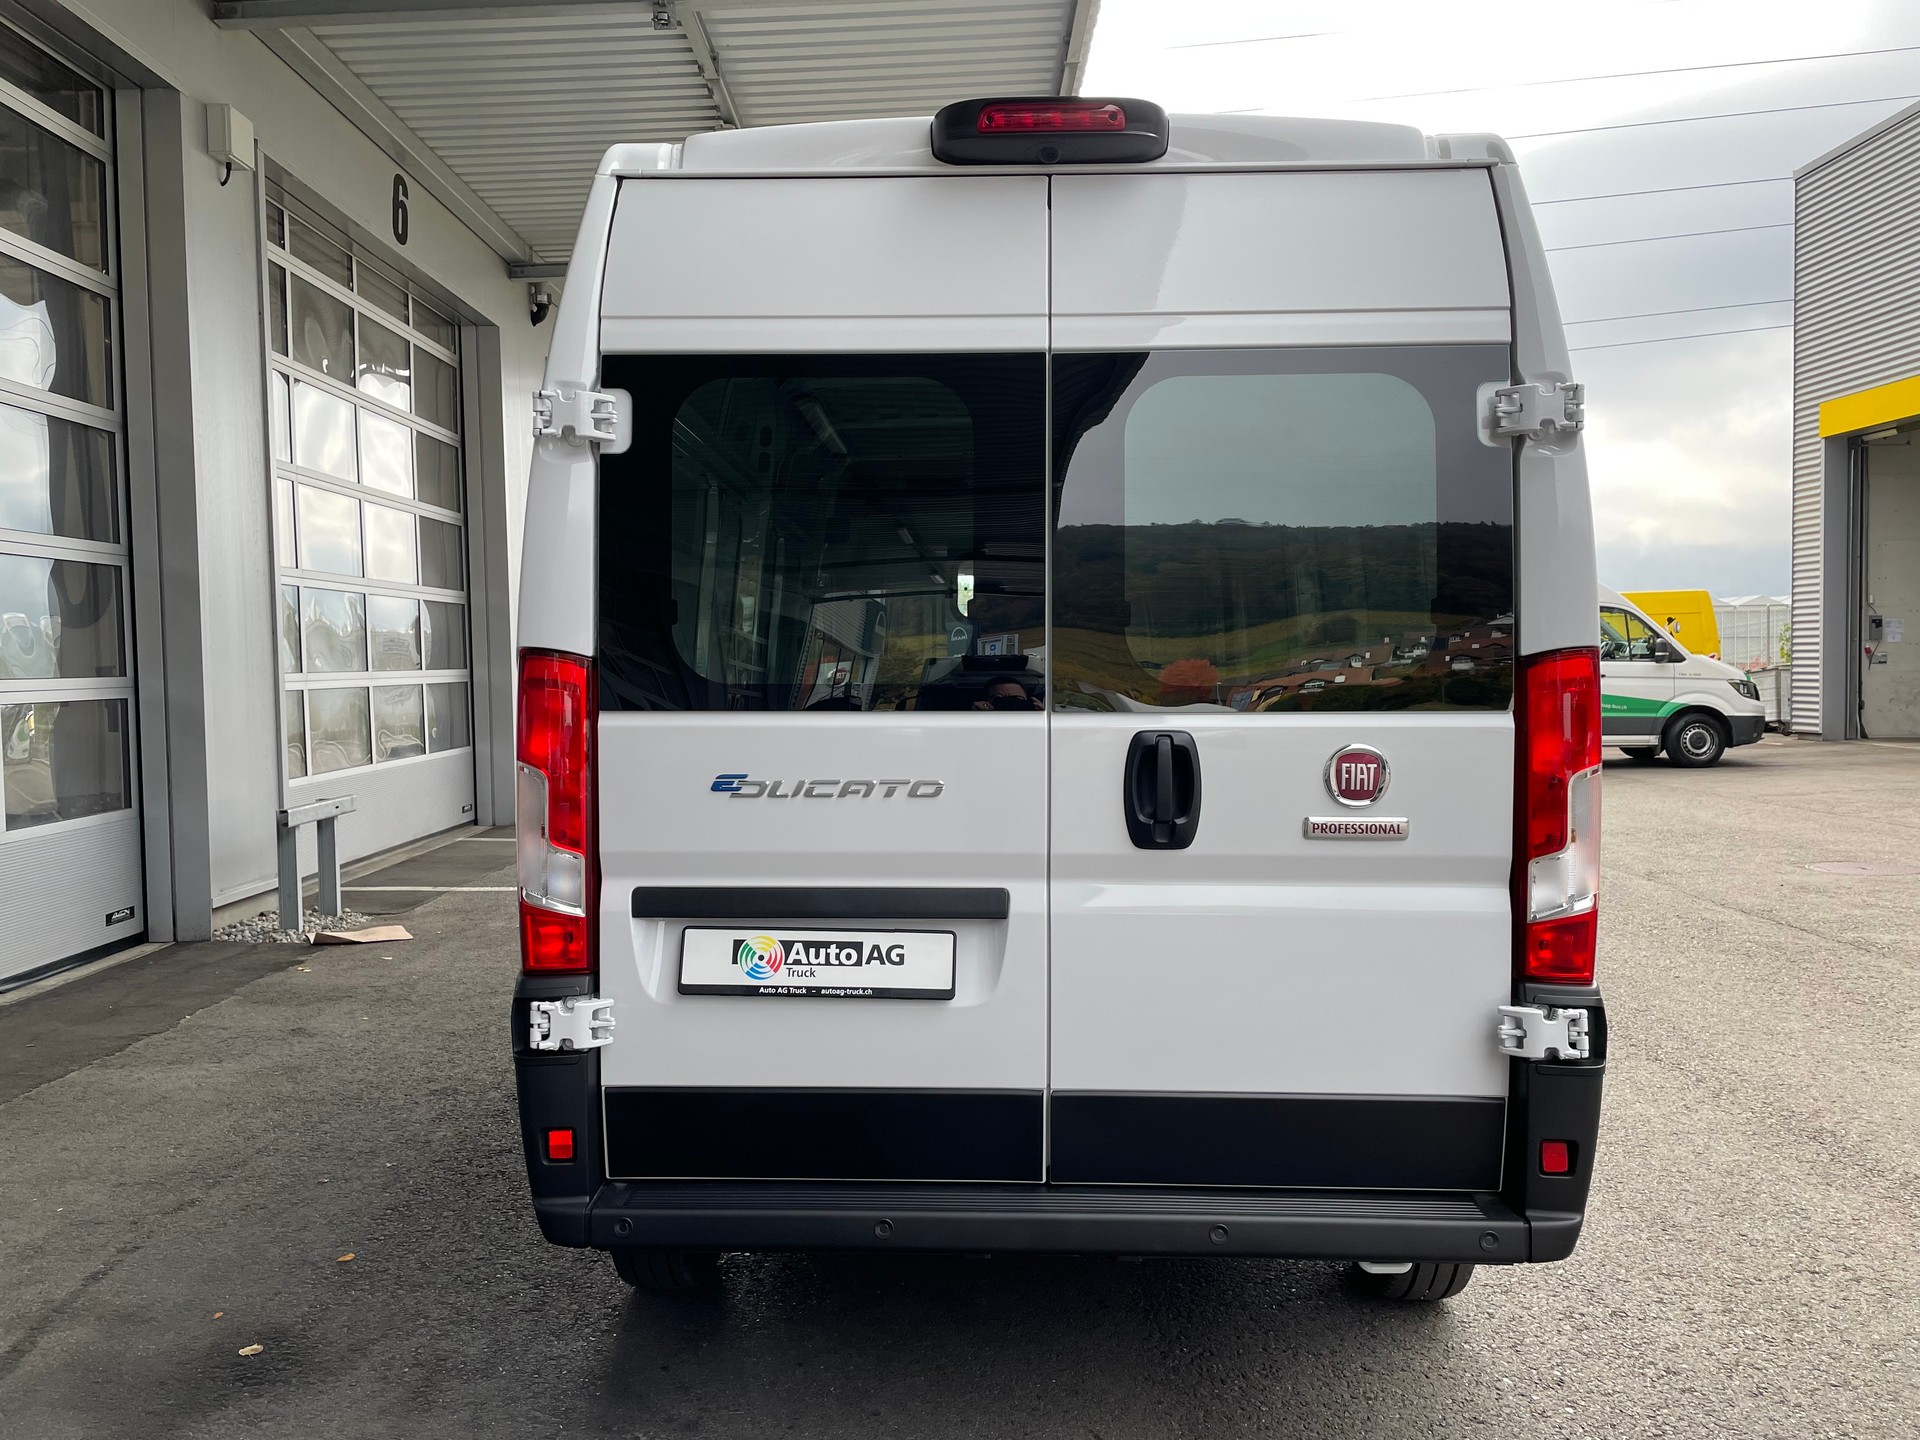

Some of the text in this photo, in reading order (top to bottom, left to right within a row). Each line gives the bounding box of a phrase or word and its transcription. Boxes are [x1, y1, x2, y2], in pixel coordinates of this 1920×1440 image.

[392, 173, 409, 246] 6
[1341, 763, 1378, 791] FIAT
[1312, 823, 1403, 835] PROFESSIONAL
[786, 943, 905, 966] Auto AG
[786, 967, 816, 978] Truck
[759, 986, 776, 994] Auto
[820, 988, 873, 996] autoag-truck.ch
